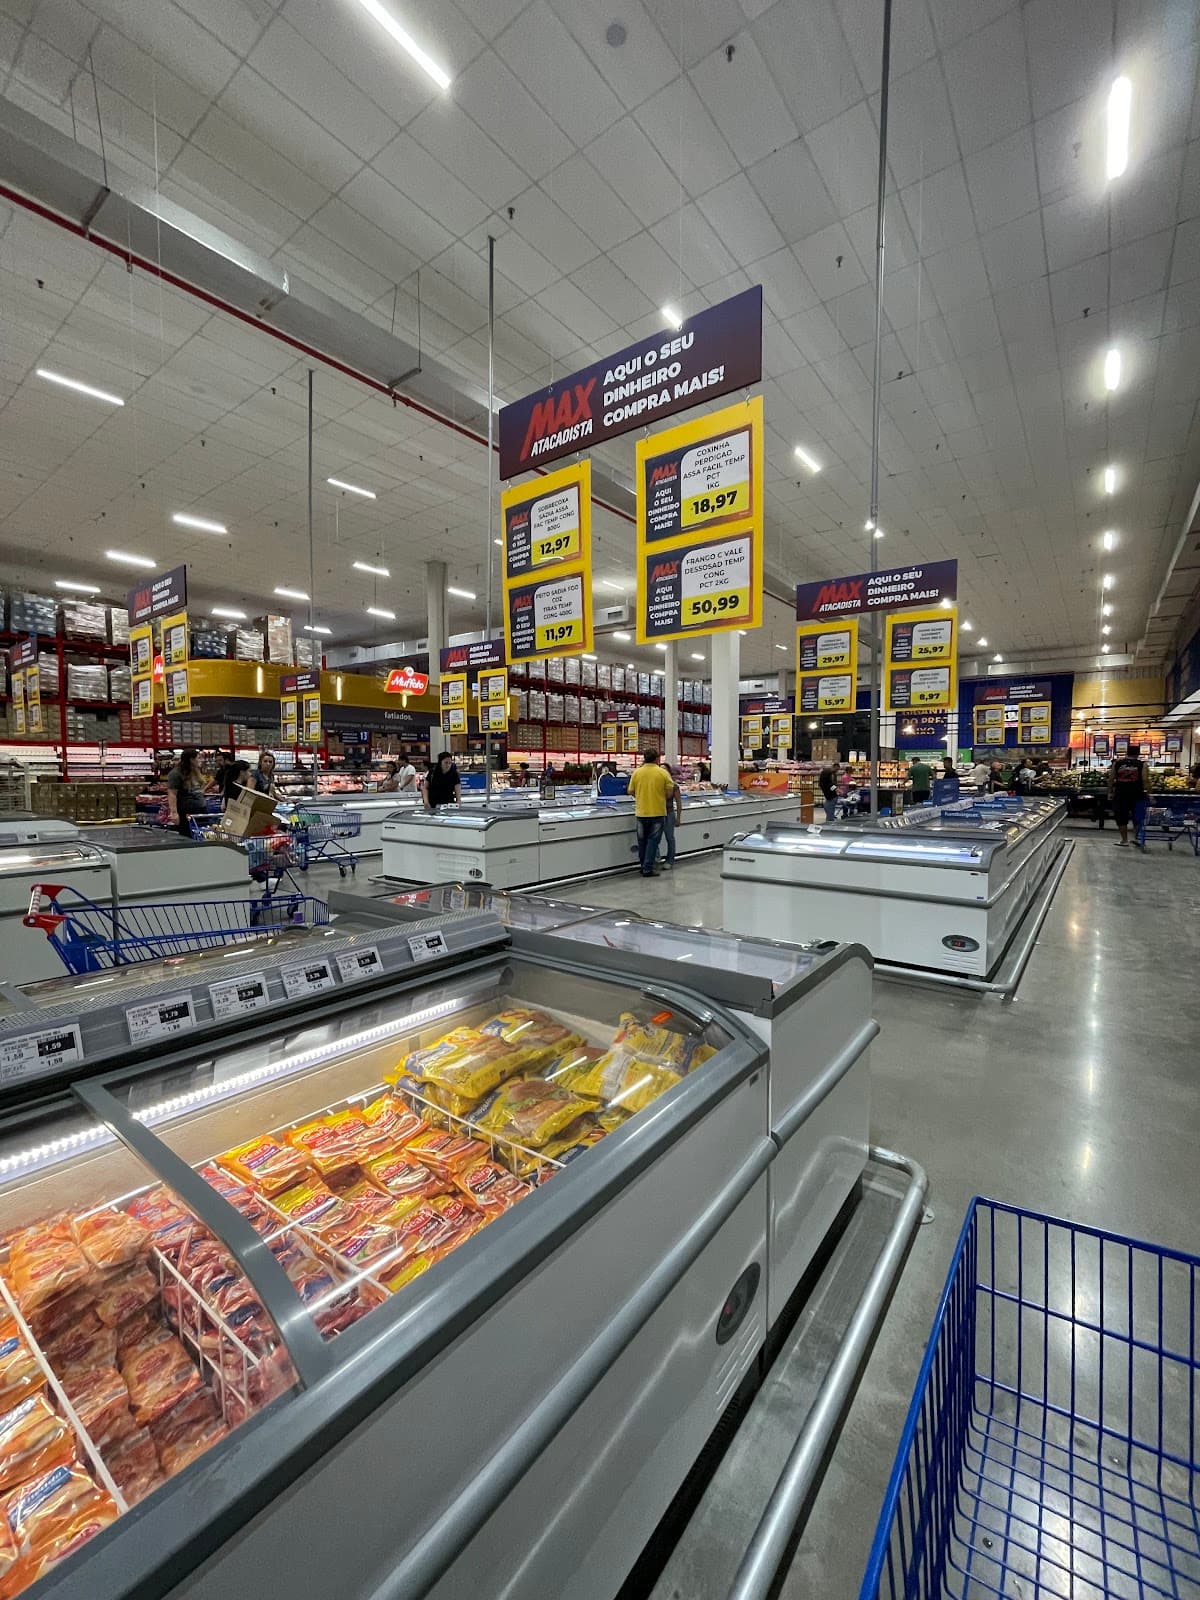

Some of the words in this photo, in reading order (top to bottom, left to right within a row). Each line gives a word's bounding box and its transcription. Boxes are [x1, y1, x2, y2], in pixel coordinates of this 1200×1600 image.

[603, 356, 642, 386] AQUI
[644, 350, 658, 367] O
[659, 332, 695, 360] SEU
[603, 362, 682, 408] DINHEIRO
[603, 389, 672, 427] COMPRA
[673, 365, 725, 397] MAIS!
[519, 376, 597, 462] MAX
[531, 418, 593, 457] ATACADISTA
[696, 441, 730, 457] COXINHA
[683, 470, 700, 479] ASSA
[702, 463, 723, 473] FACIL
[724, 454, 745, 466] TEMP
[694, 449, 733, 467] PERDIGAO
[650, 462, 678, 487] MAX
[706, 472, 720, 480] PCT
[655, 487, 672, 498] AQUI
[660, 495, 674, 504] SEU
[648, 502, 680, 517] DINHEIRO
[692, 490, 738, 515] 18,97
[649, 511, 678, 524] COMPRA
[540, 535, 570, 555] 12,97
[686, 553, 716, 565] FRANGO
[723, 547, 743, 557] VALE
[684, 561, 723, 575] DESSOSAD
[725, 556, 745, 566] TEMP
[703, 569, 725, 579] CONG
[699, 581, 713, 589] PCT
[867, 575, 892, 586] AQUI
[893, 574, 901, 582] O
[902, 570, 923, 579] SEU
[656, 586, 673, 595] AQUI
[812, 580, 864, 613] MAX
[867, 582, 915, 595] DINHEIRO
[661, 593, 674, 602] SEU
[692, 595, 740, 616] 50,99
[819, 599, 861, 612] ATACADISTA
[867, 594, 909, 606] COMPRA
[909, 589, 939, 601] MAIS!
[650, 609, 678, 620] COMPRA
[545, 625, 573, 642] 11,97
